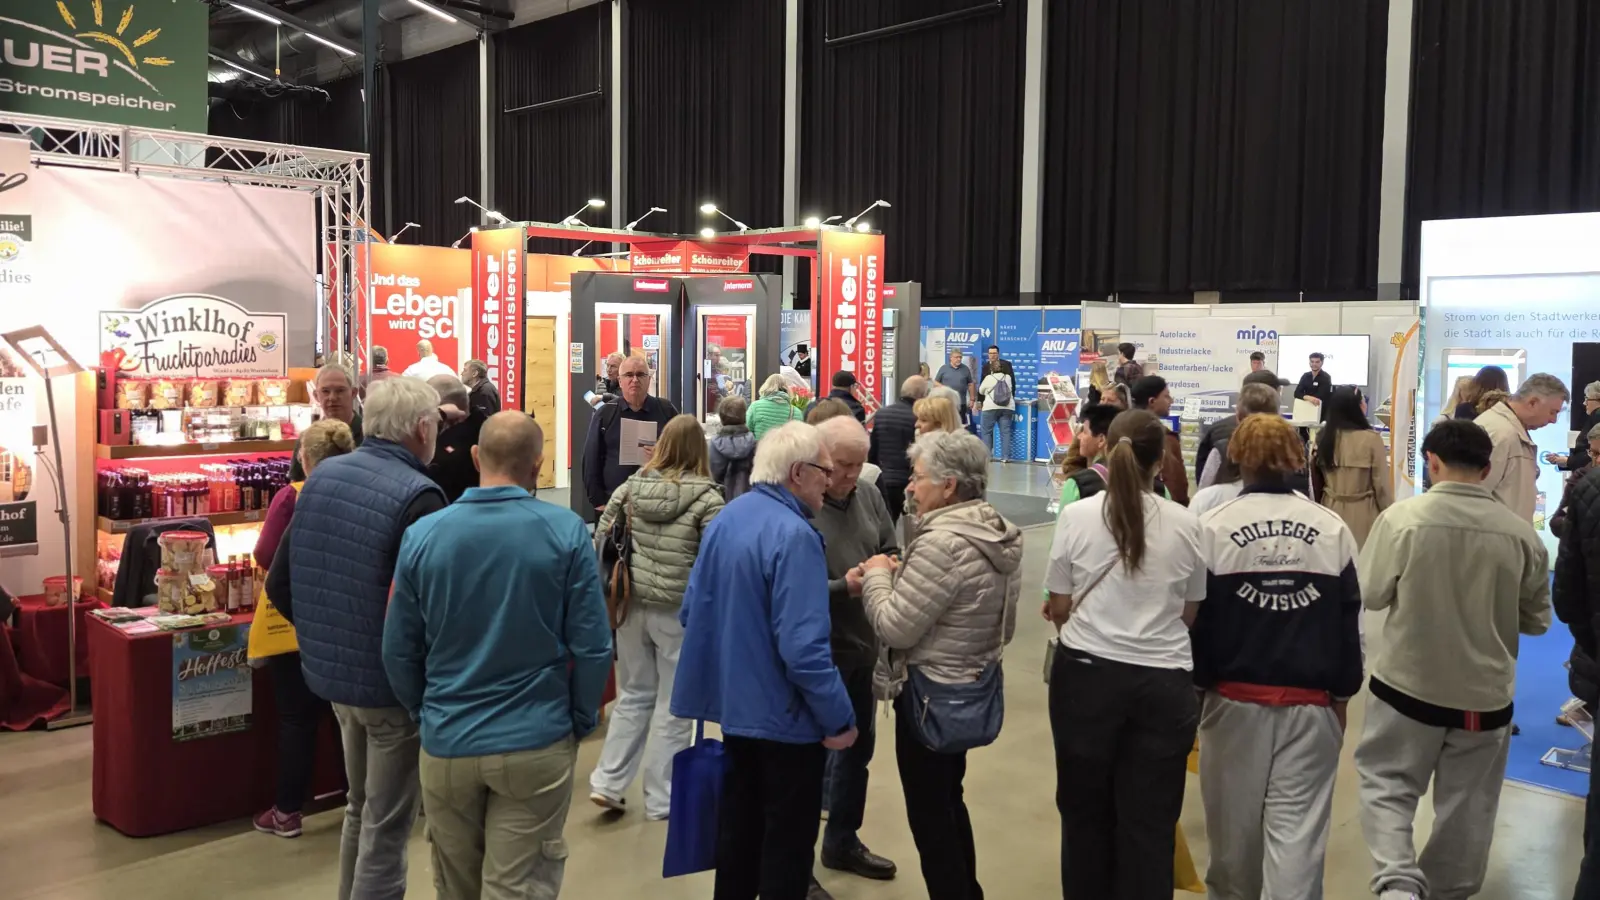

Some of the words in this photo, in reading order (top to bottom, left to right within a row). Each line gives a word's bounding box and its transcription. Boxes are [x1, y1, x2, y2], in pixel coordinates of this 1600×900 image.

[0, 38, 108, 77] UER
[634, 253, 682, 266] Schönreiter
[692, 254, 743, 267] Schönreiter
[389, 318, 416, 330] wird
[1444, 313, 1476, 321] Strom
[1503, 312, 1525, 321] den
[135, 307, 254, 344] Winklhof
[505, 249, 516, 403] modernisieren
[1444, 329, 1460, 338] die
[1463, 328, 1492, 338] Stadt
[1495, 328, 1511, 338] als
[1515, 328, 1543, 338] auch
[1548, 328, 1564, 338] für
[1568, 328, 1587, 338] die
[947, 332, 969, 342] AKU
[1236, 325, 1277, 345] mipa
[1041, 340, 1066, 351] AKU
[1159, 347, 1211, 355] Industrielacke
[134, 340, 257, 377] Fruchtparadies
[1230, 520, 1320, 548] COLLEGE
[1236, 582, 1321, 611] DIVISION
[177, 648, 246, 680] Hoffest
